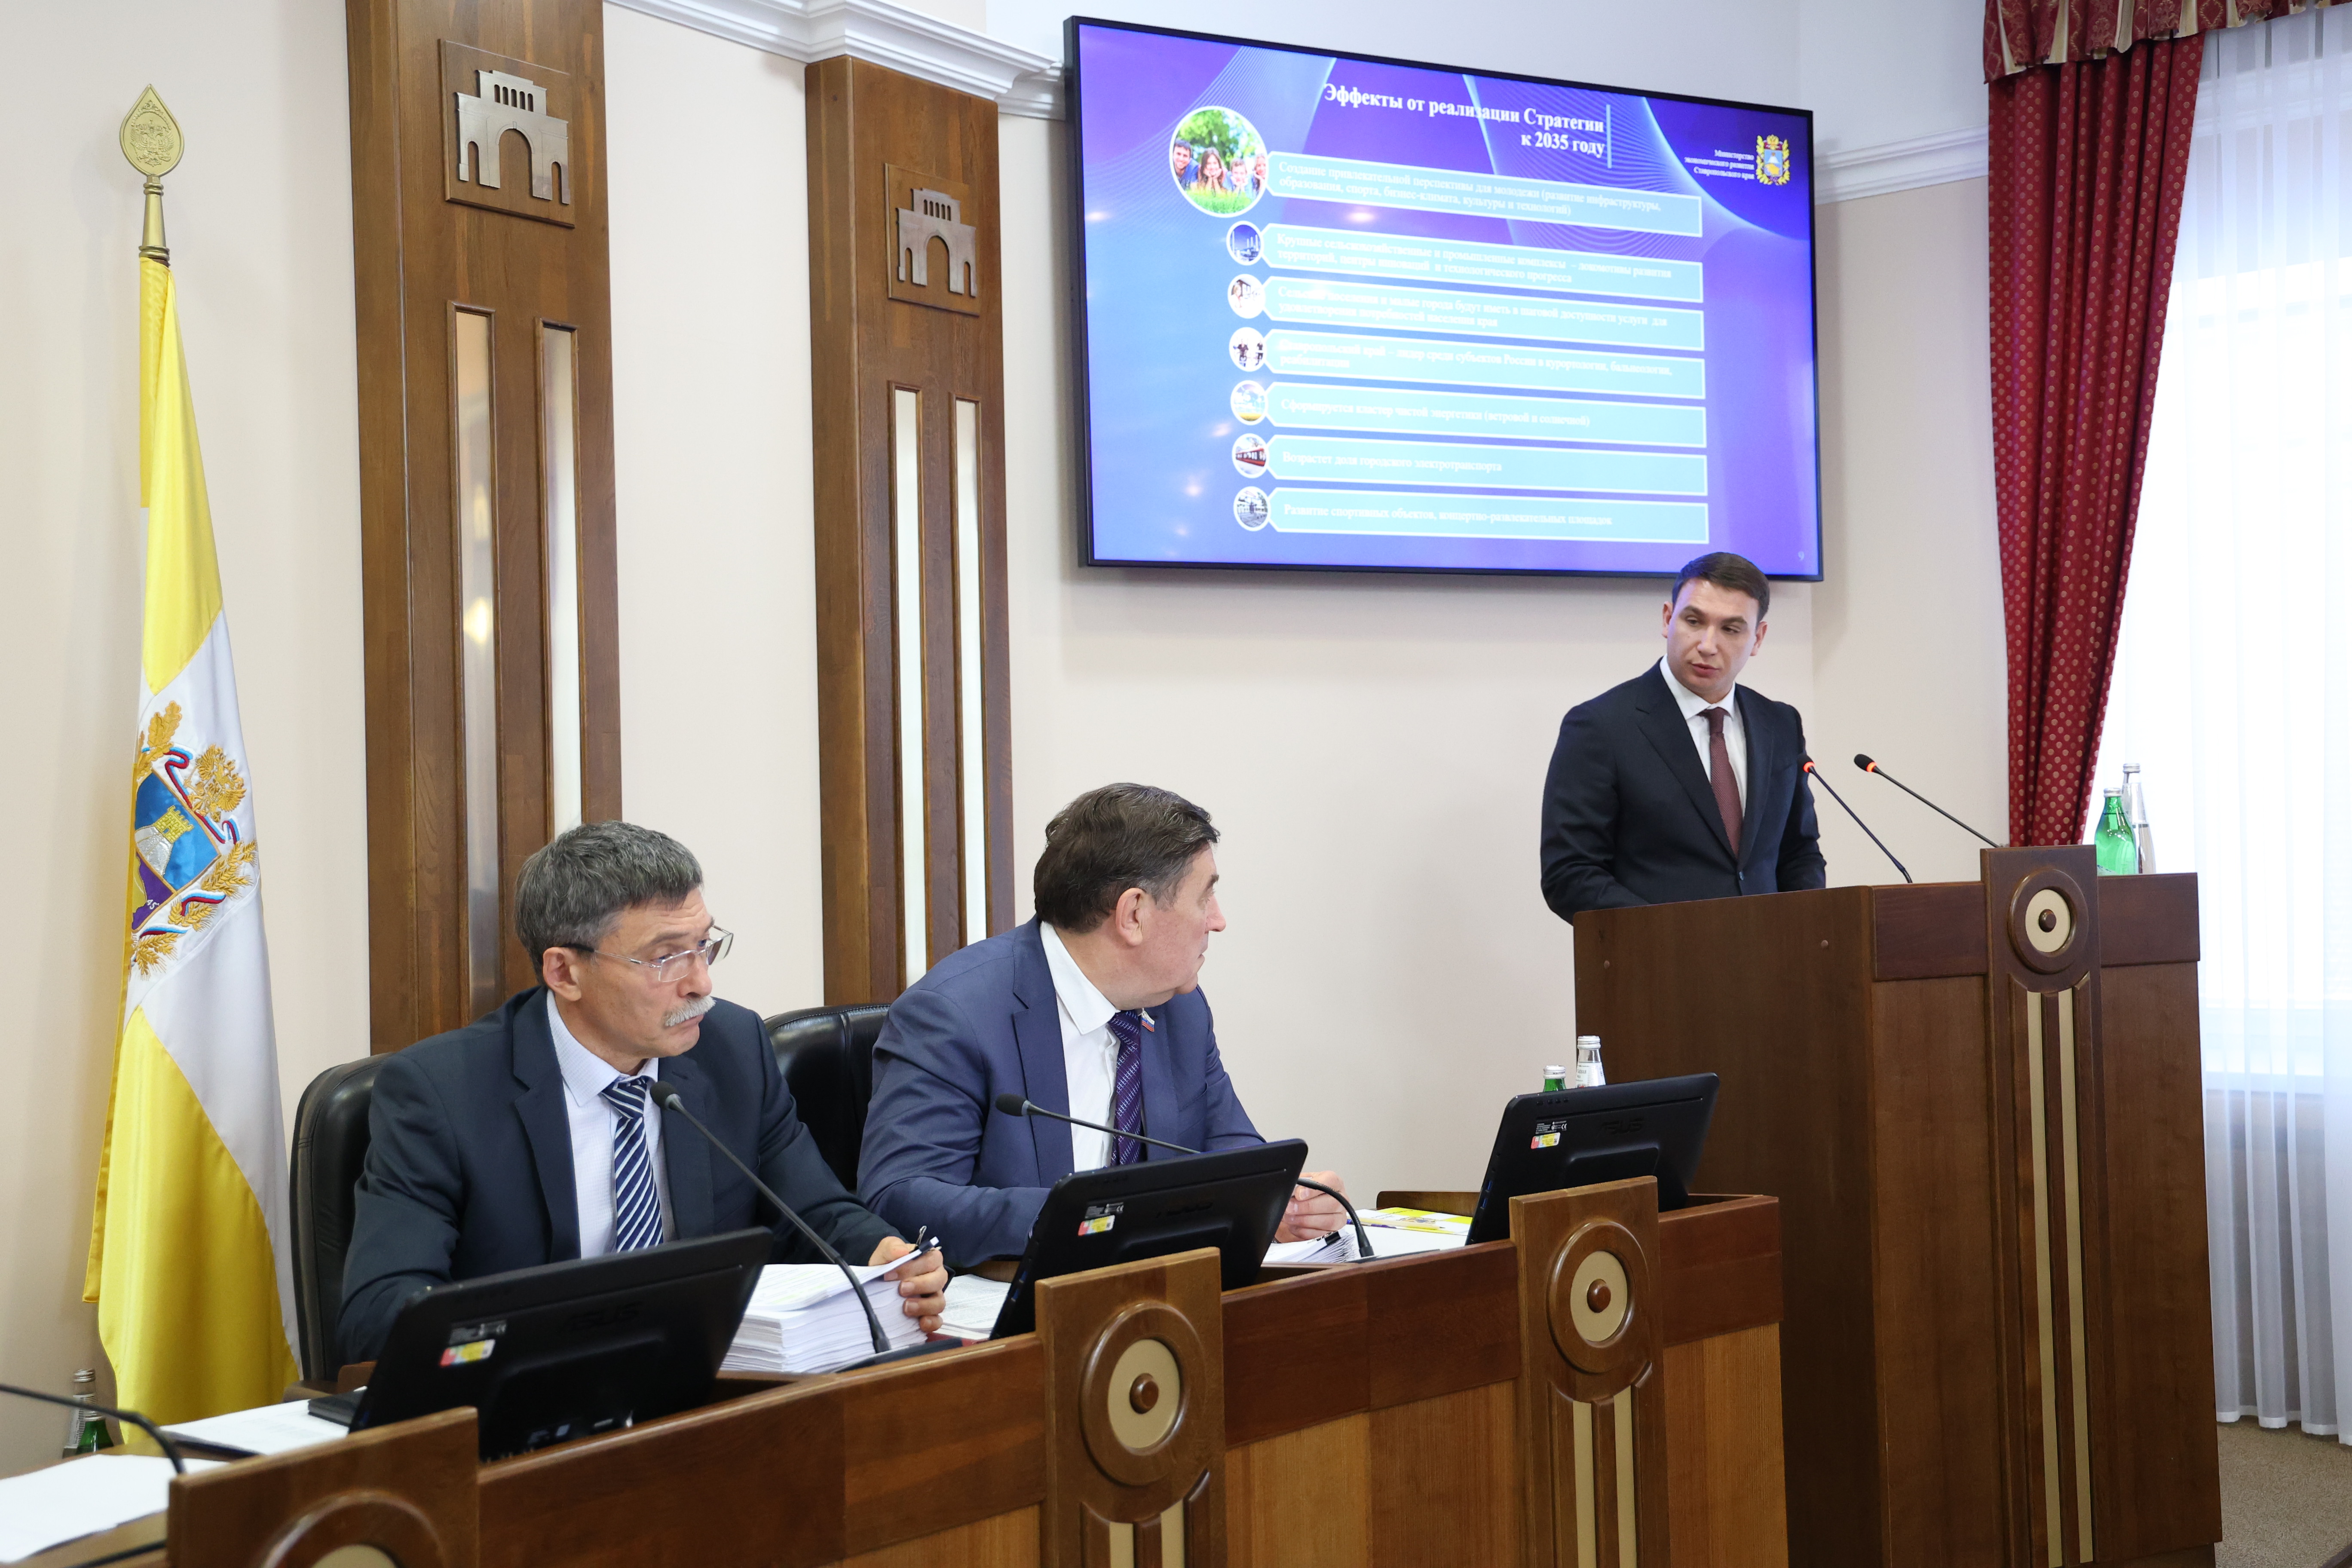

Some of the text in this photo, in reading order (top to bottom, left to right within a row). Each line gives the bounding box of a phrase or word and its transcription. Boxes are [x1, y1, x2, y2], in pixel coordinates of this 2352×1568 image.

[1324, 83, 1604, 132] Эффекты от реализации Стратегии
[1521, 132, 1605, 158] к 2035 году
[1279, 162, 1661, 211] Создание привлекательной перспективы для молодежи (развитие инфраструктуры,
[1279, 176, 1344, 193] образования,
[1346, 184, 1381, 197] спорта,
[1384, 186, 1461, 205] бизнес-климата,
[1463, 196, 1505, 209] культуры
[1516, 201, 1571, 216] технологий)
[1277, 233, 1322, 247] Крупные
[1324, 240, 1432, 257] сельскохозяйственные
[1442, 250, 1515, 264] промышленные
[1517, 257, 1566, 268] комплексы
[1578, 262, 1631, 274] локомотивы
[1633, 267, 1672, 278] развития
[1277, 250, 1337, 264] территорий,
[1340, 255, 1375, 267] центры
[1378, 258, 1430, 270] инноваций
[1443, 264, 1525, 278] технологического
[1527, 271, 1572, 283] прогресса
[1279, 303, 1498, 328] удовлетворения потребностей населения края
[1328, 293, 1378, 304] поселения
[1389, 297, 1420, 307] малые
[1422, 300, 1453, 311] города
[1455, 300, 1481, 314] будут
[1484, 305, 1511, 314] иметь
[1520, 307, 1558, 318] шаговой
[1560, 310, 1616, 322] доступности
[1618, 315, 1648, 326] услуги
[1651, 317, 1667, 326] для
[1280, 355, 1350, 368] реабилитации
[1363, 346, 1386, 358] край
[1396, 349, 1424, 361] лидер
[1426, 351, 1454, 361] среди
[1456, 351, 1501, 364] субъектов
[1504, 353, 1536, 365] России
[1546, 358, 1609, 372] курортологии,
[1281, 399, 1354, 414] Сформируется
[1356, 406, 1393, 418] кластер
[1395, 407, 1428, 417] чистой
[1430, 410, 1482, 421] энергетики
[1485, 410, 1529, 424] (ветровой
[1540, 415, 1590, 428] солнечной)
[1283, 452, 1502, 473] Возрастет доля городского электротранспорта
[1284, 504, 1329, 516] Развитие
[1331, 508, 1389, 519] спортивных
[1392, 508, 1437, 521] объектов,
[1568, 516, 1613, 526] площадок
[1798, 551, 1805, 561] 9
